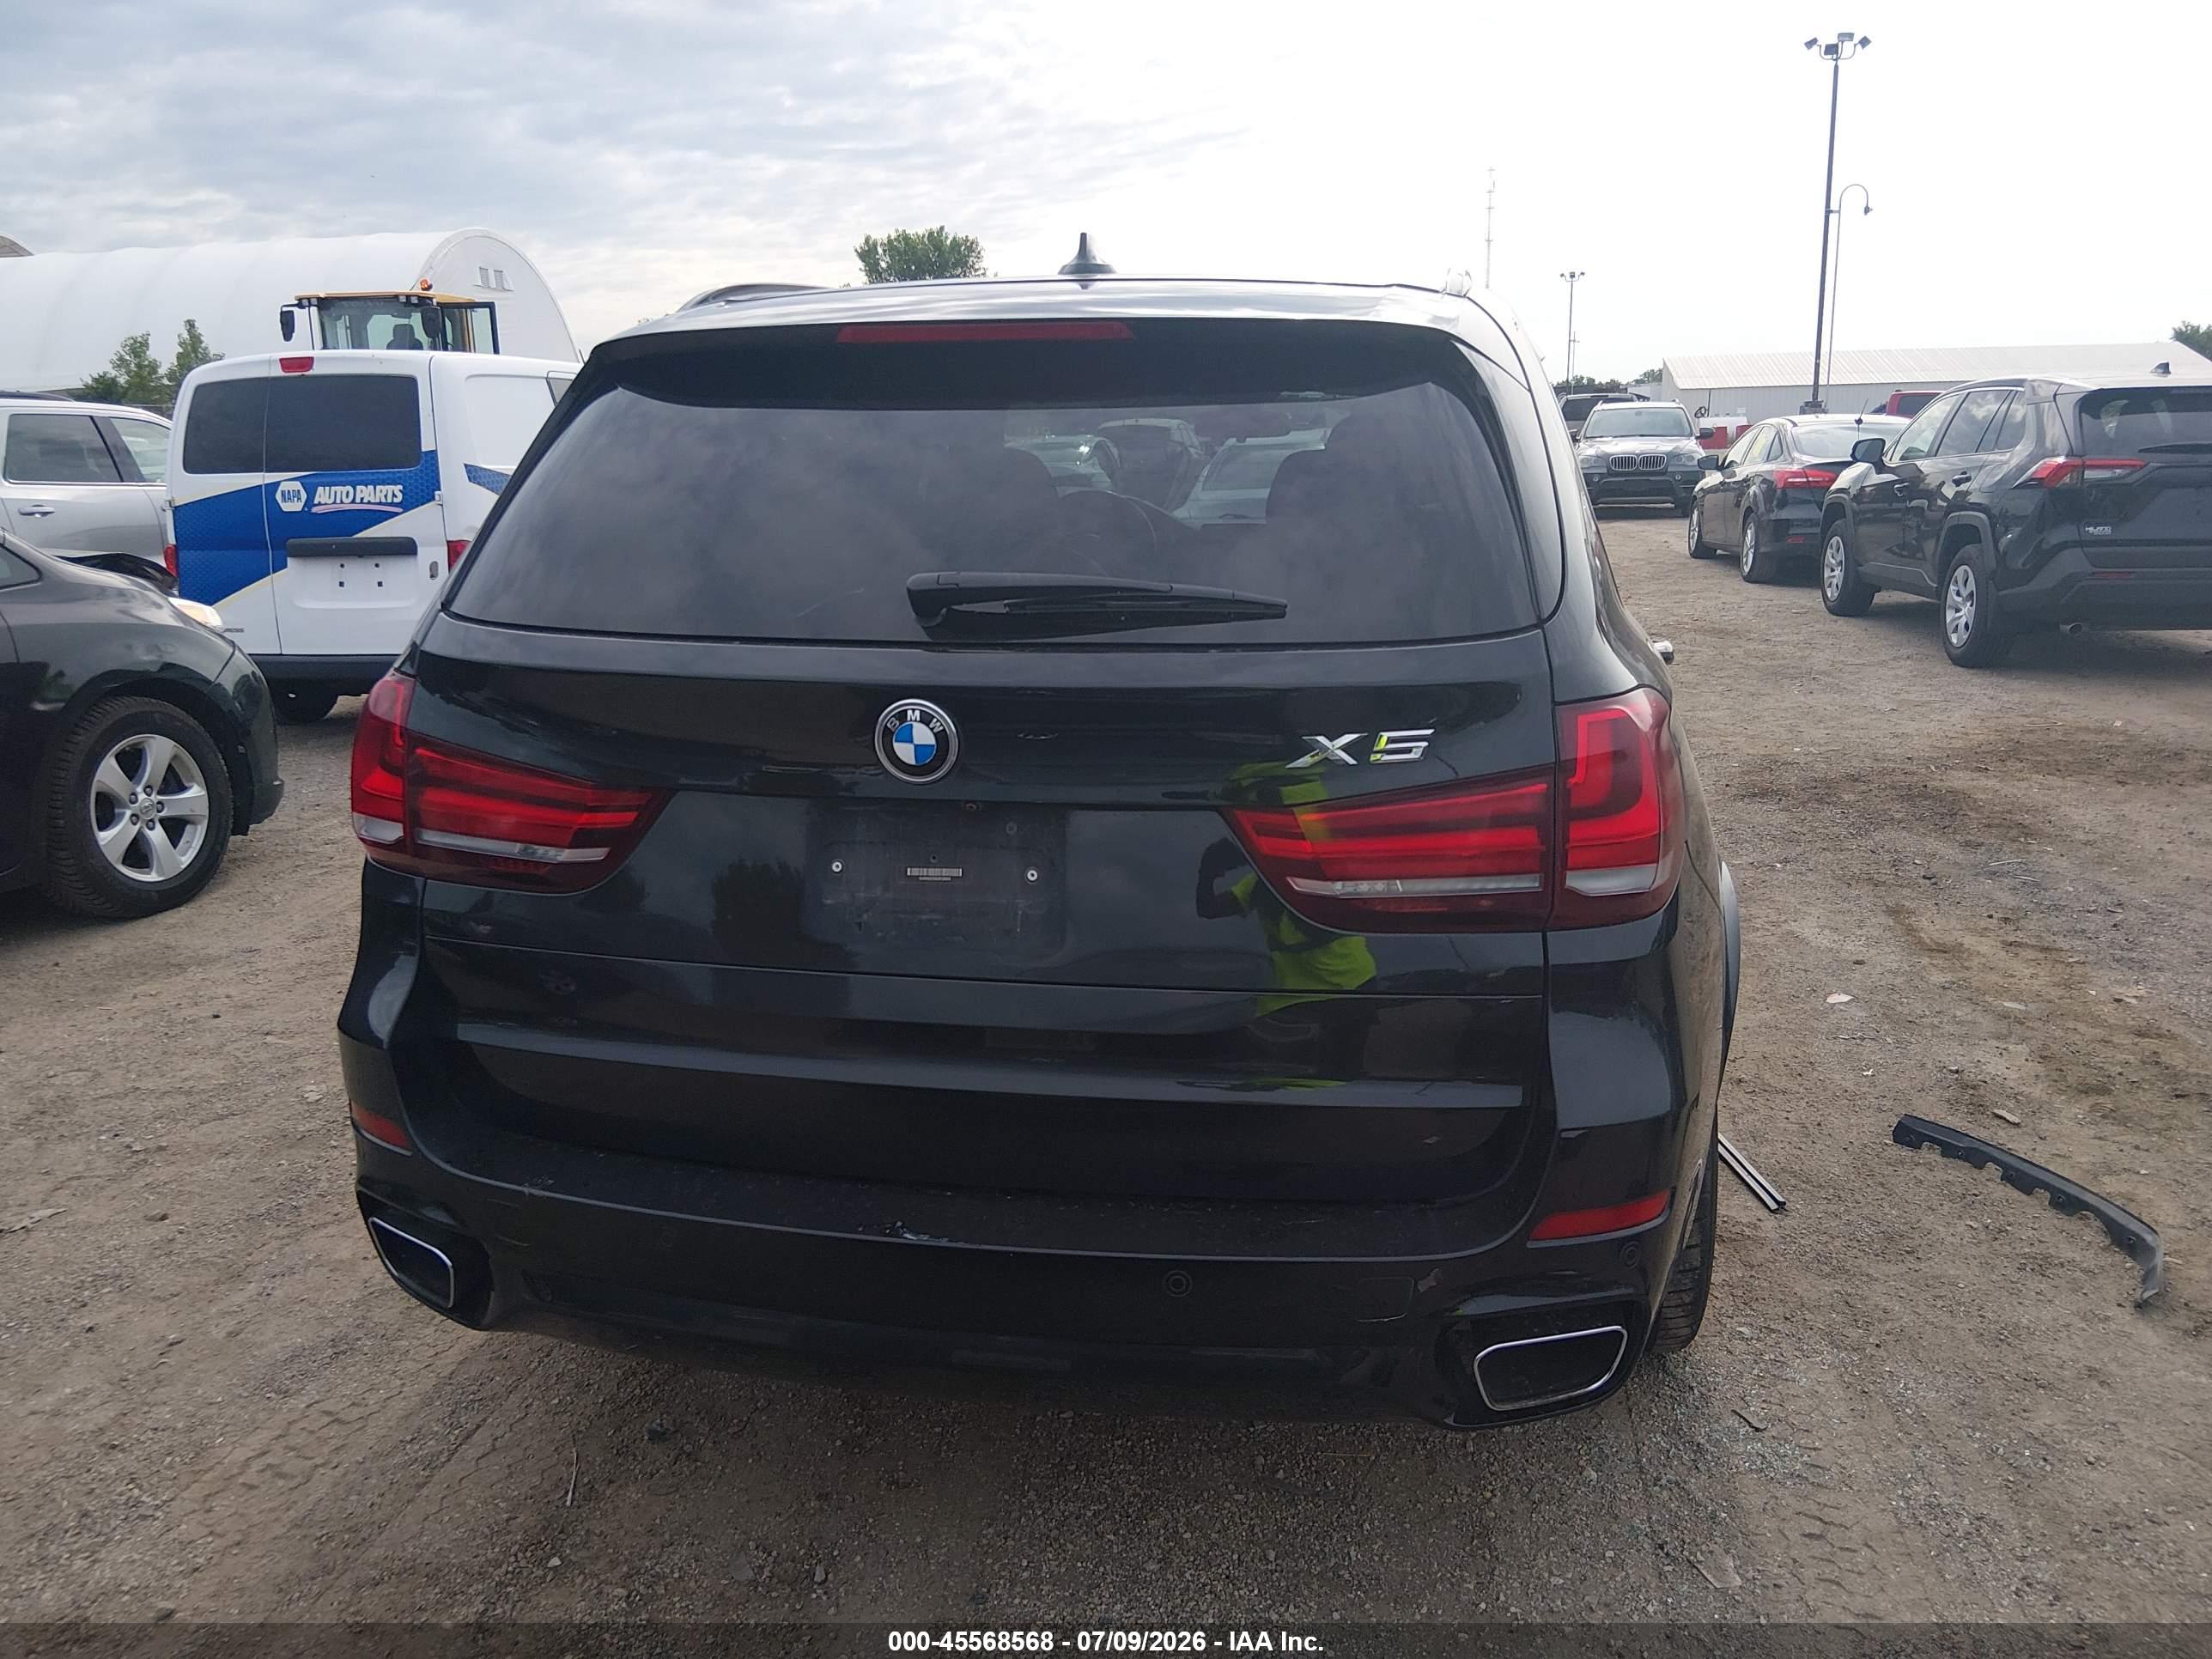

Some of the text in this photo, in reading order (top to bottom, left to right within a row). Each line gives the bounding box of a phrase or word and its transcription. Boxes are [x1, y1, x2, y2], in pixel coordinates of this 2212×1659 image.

[281, 485, 403, 504] NAPA AUTO PARTS
[886, 709, 945, 733] BMW
[1285, 729, 1435, 769] X5
